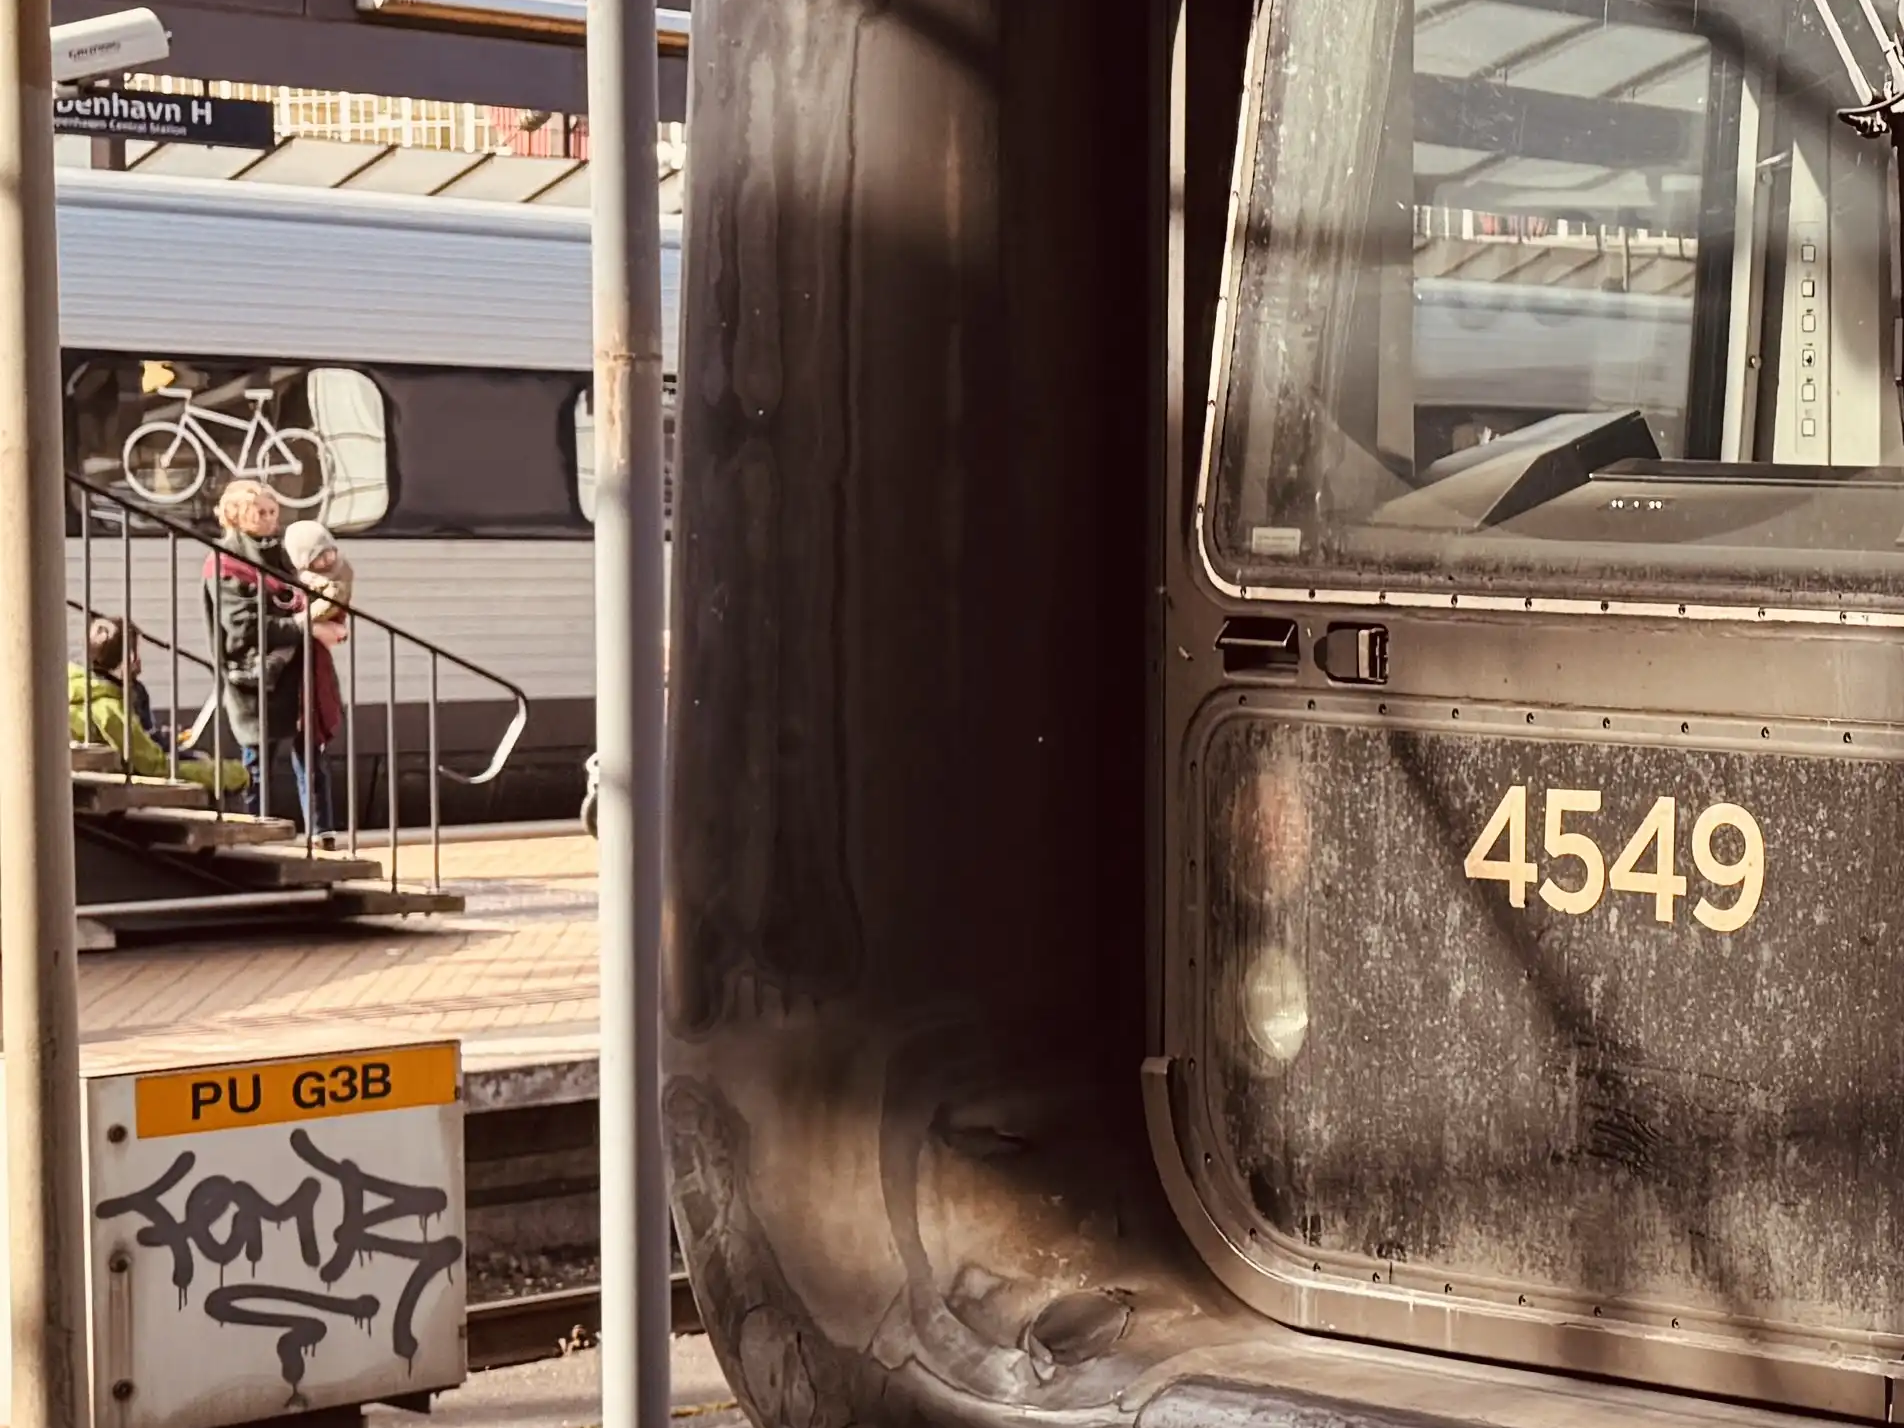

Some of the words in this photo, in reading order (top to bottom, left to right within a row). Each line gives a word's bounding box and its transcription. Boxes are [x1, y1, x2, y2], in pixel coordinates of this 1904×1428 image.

[191, 100, 213, 126] H
[1463, 784, 1767, 934] 4549
[190, 1073, 263, 1121] PU
[290, 1061, 393, 1111] G3B
